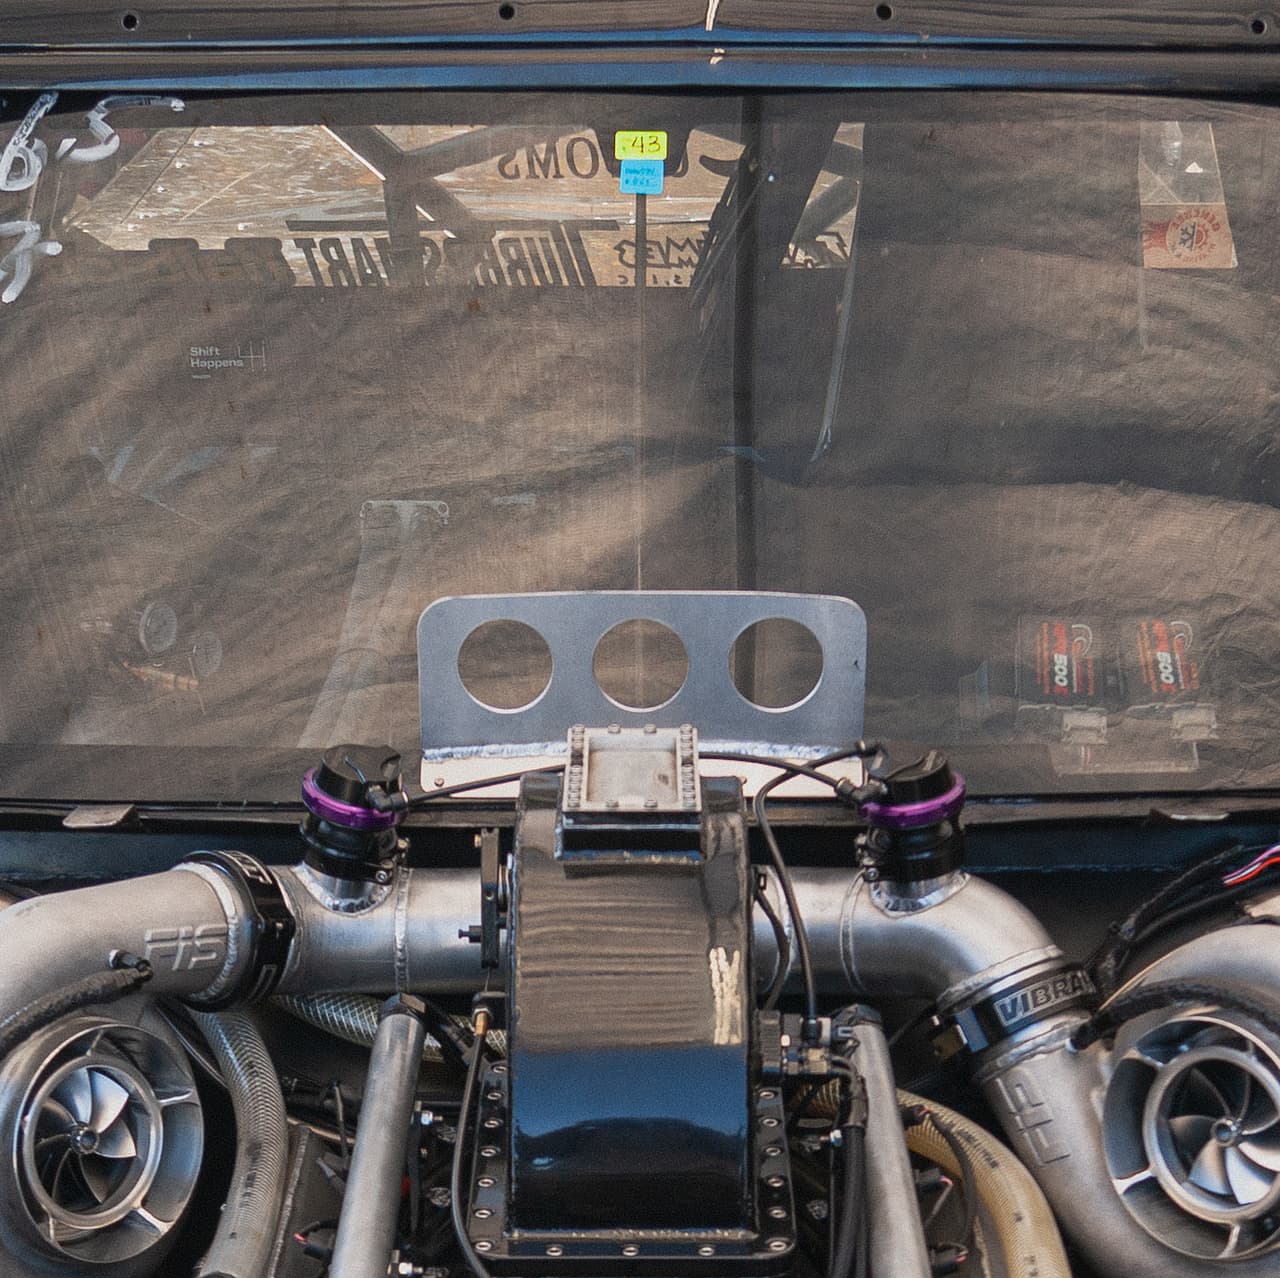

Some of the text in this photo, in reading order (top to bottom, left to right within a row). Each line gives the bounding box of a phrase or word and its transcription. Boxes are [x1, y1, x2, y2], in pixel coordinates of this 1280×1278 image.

[190, 346, 220, 357] Shift
[191, 359, 244, 369] Happens
[993, 970, 1096, 1026] VIBRA
